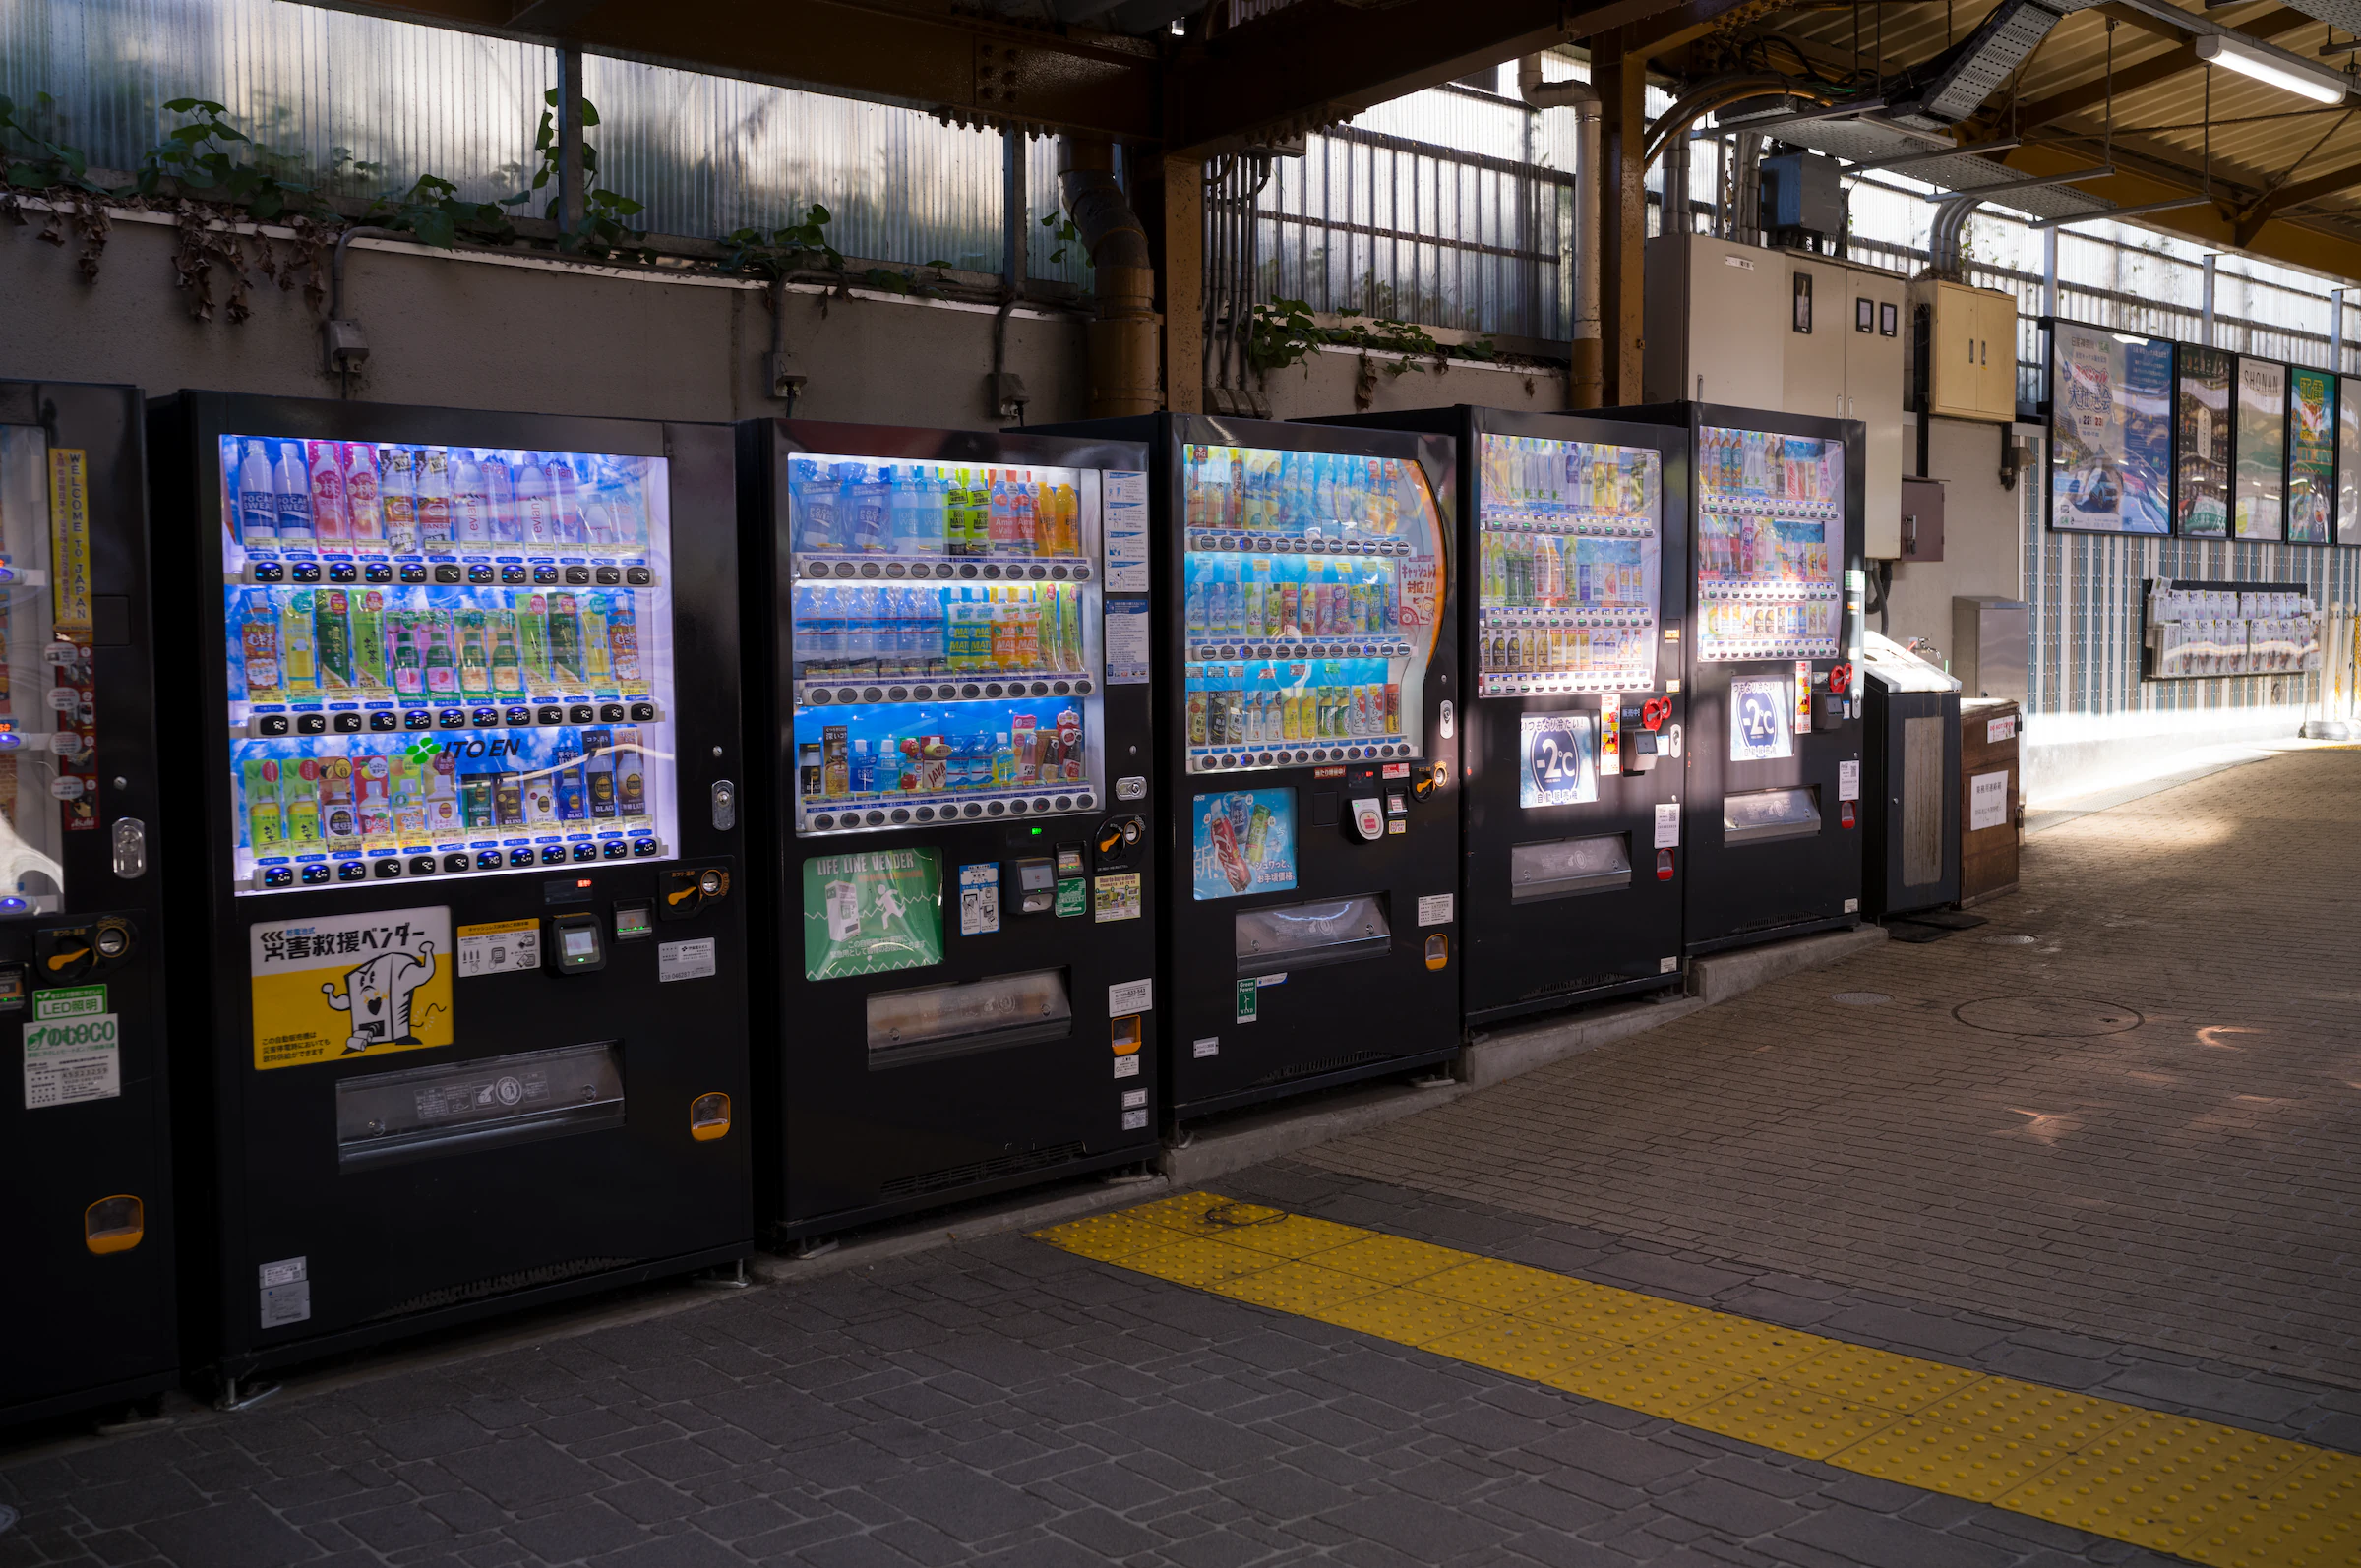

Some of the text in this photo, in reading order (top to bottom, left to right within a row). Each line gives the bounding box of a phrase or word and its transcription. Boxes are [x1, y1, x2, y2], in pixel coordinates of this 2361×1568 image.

[2244, 370, 2278, 393] SHONAN
[466, 499, 479, 531] evian
[530, 502, 542, 533] evian
[69, 452, 86, 619] WELCOME TO JAPAN
[442, 739, 520, 758] ITO EN
[928, 762, 946, 785] JAVA
[817, 859, 839, 876] LIFE
[844, 856, 867, 873] LINE
[871, 853, 914, 871] VENDER
[1255, 860, 1290, 871] シュワっと、
[260, 922, 425, 962] 災害救援ベンダー
[43, 998, 97, 1015] LED照明
[262, 1031, 317, 1045] この自動販売機は
